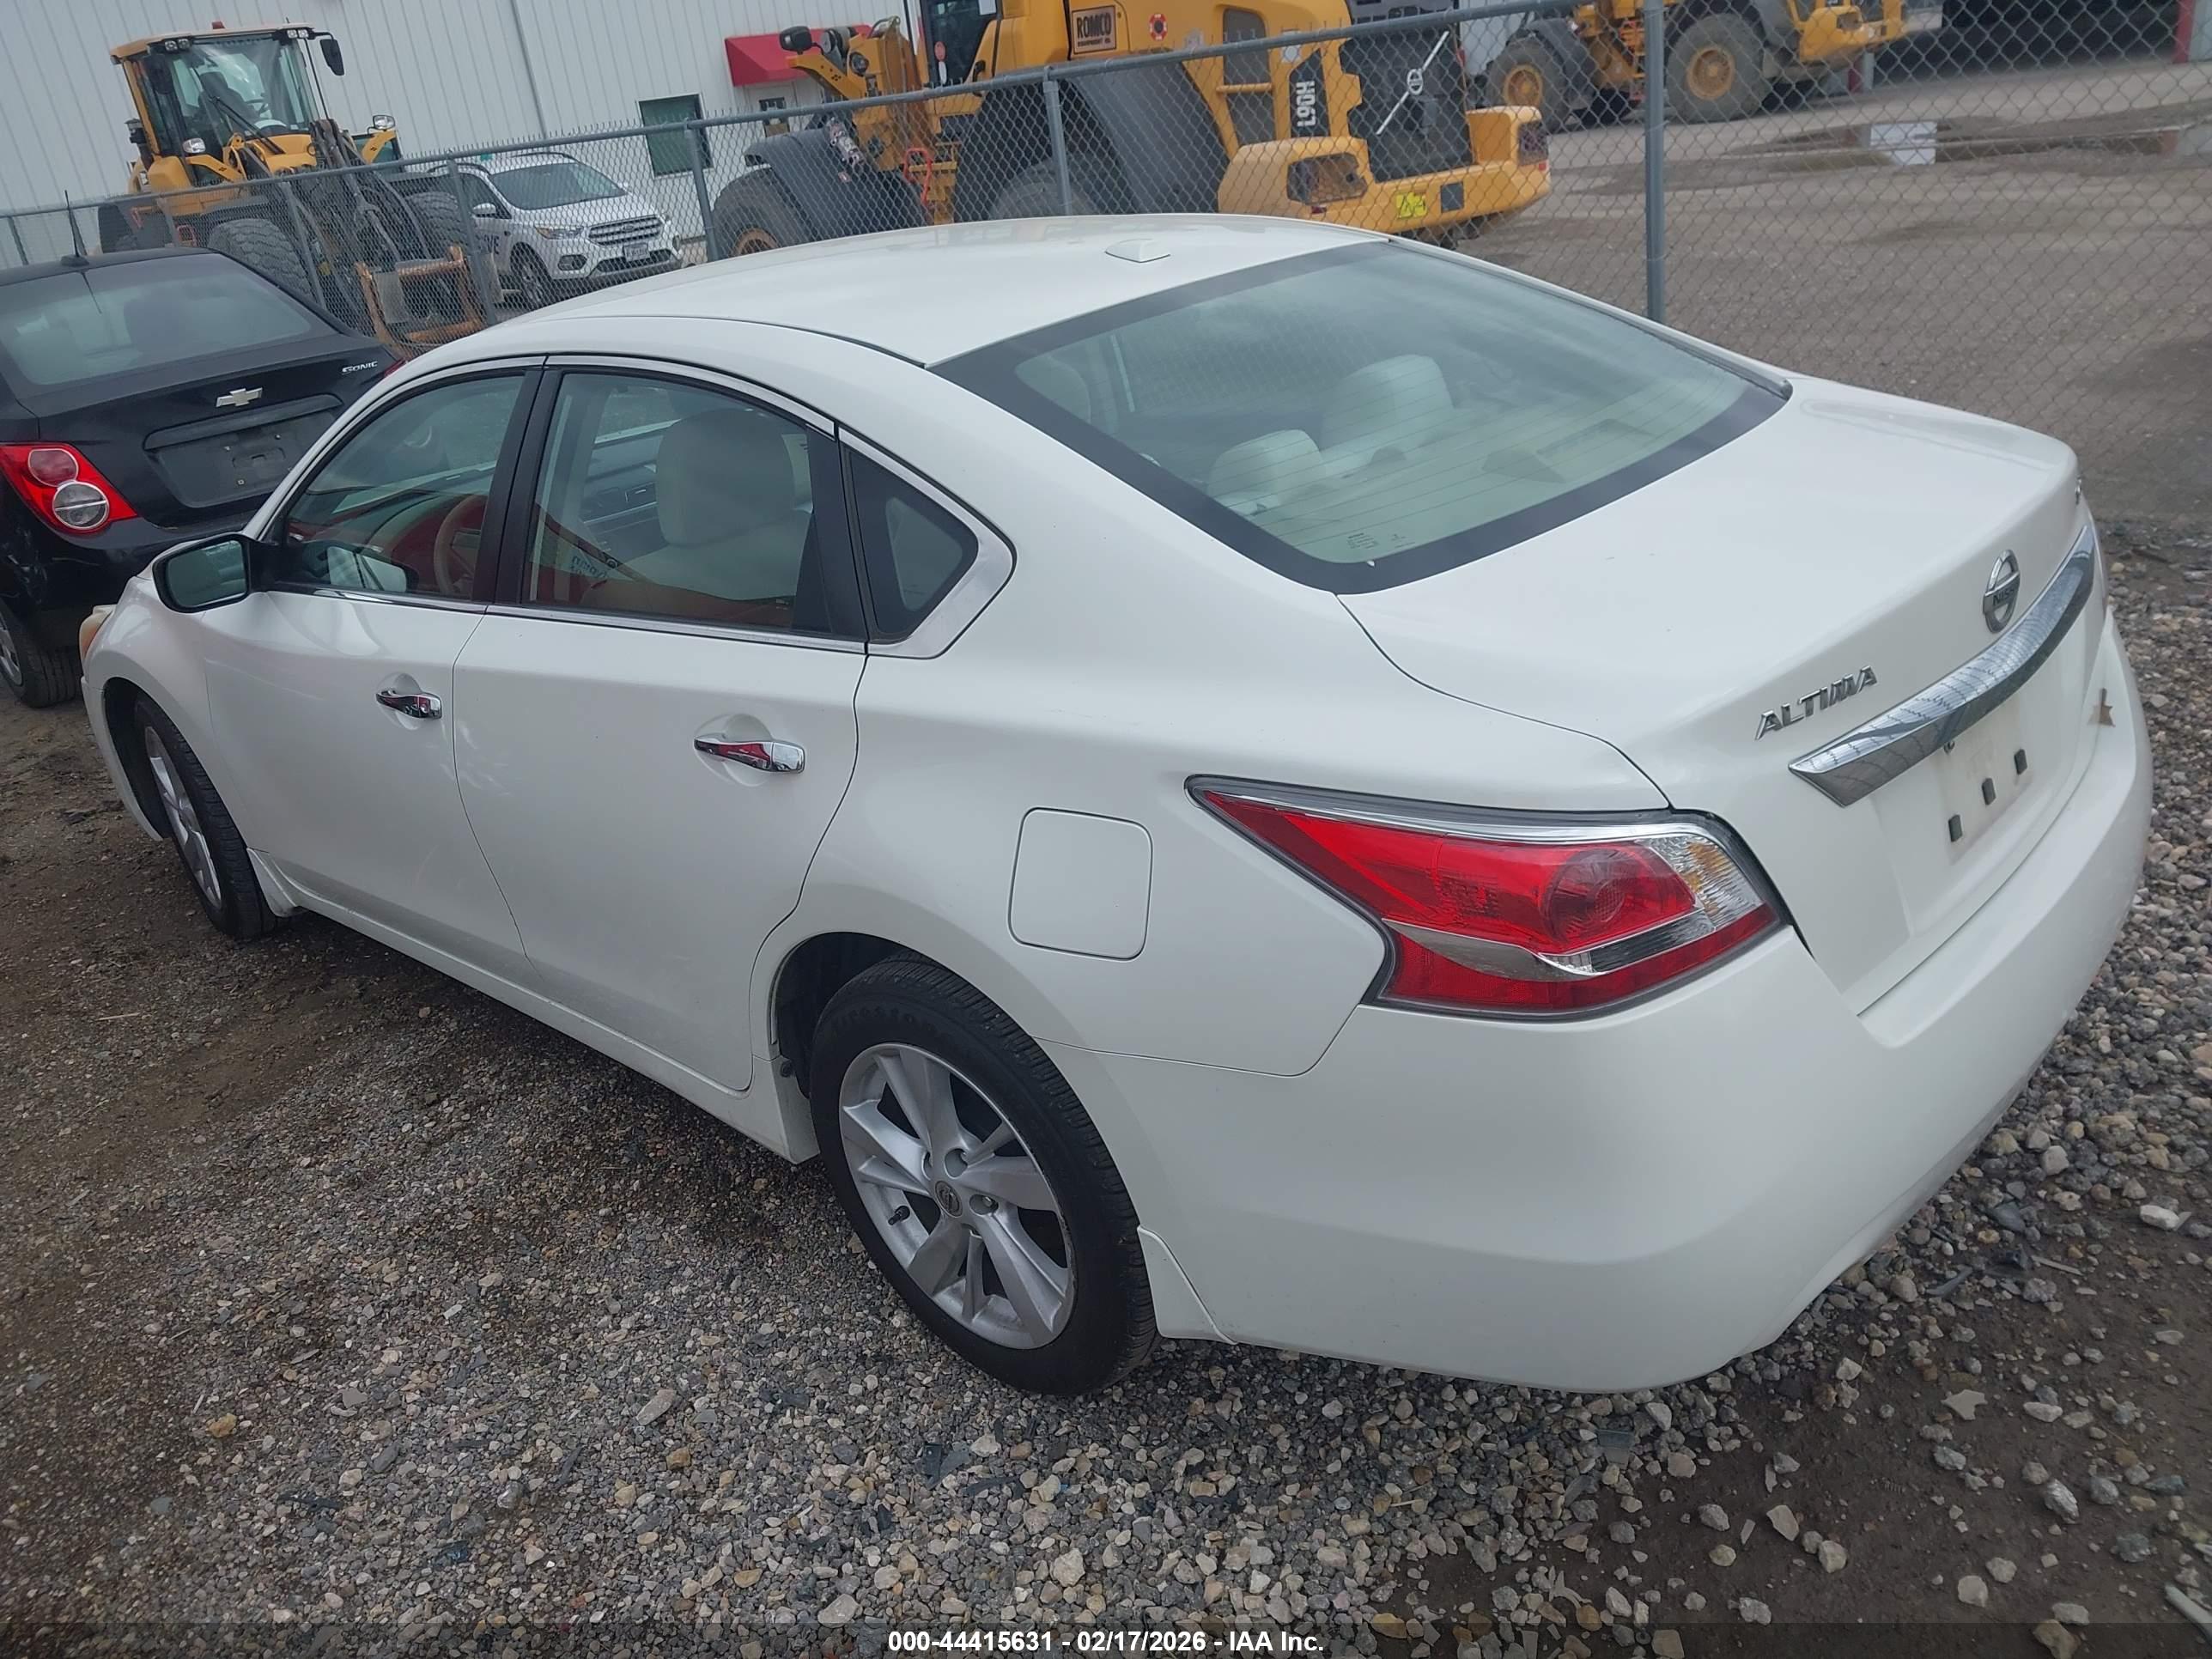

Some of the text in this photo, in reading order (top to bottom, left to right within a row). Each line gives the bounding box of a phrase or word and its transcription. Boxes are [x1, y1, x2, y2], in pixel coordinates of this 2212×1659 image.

[1077, 13, 1111, 38] ROMCO
[1296, 81, 1316, 127] L90H
[342, 361, 378, 374] SONIC
[1755, 665, 1878, 740] ALTIMA
